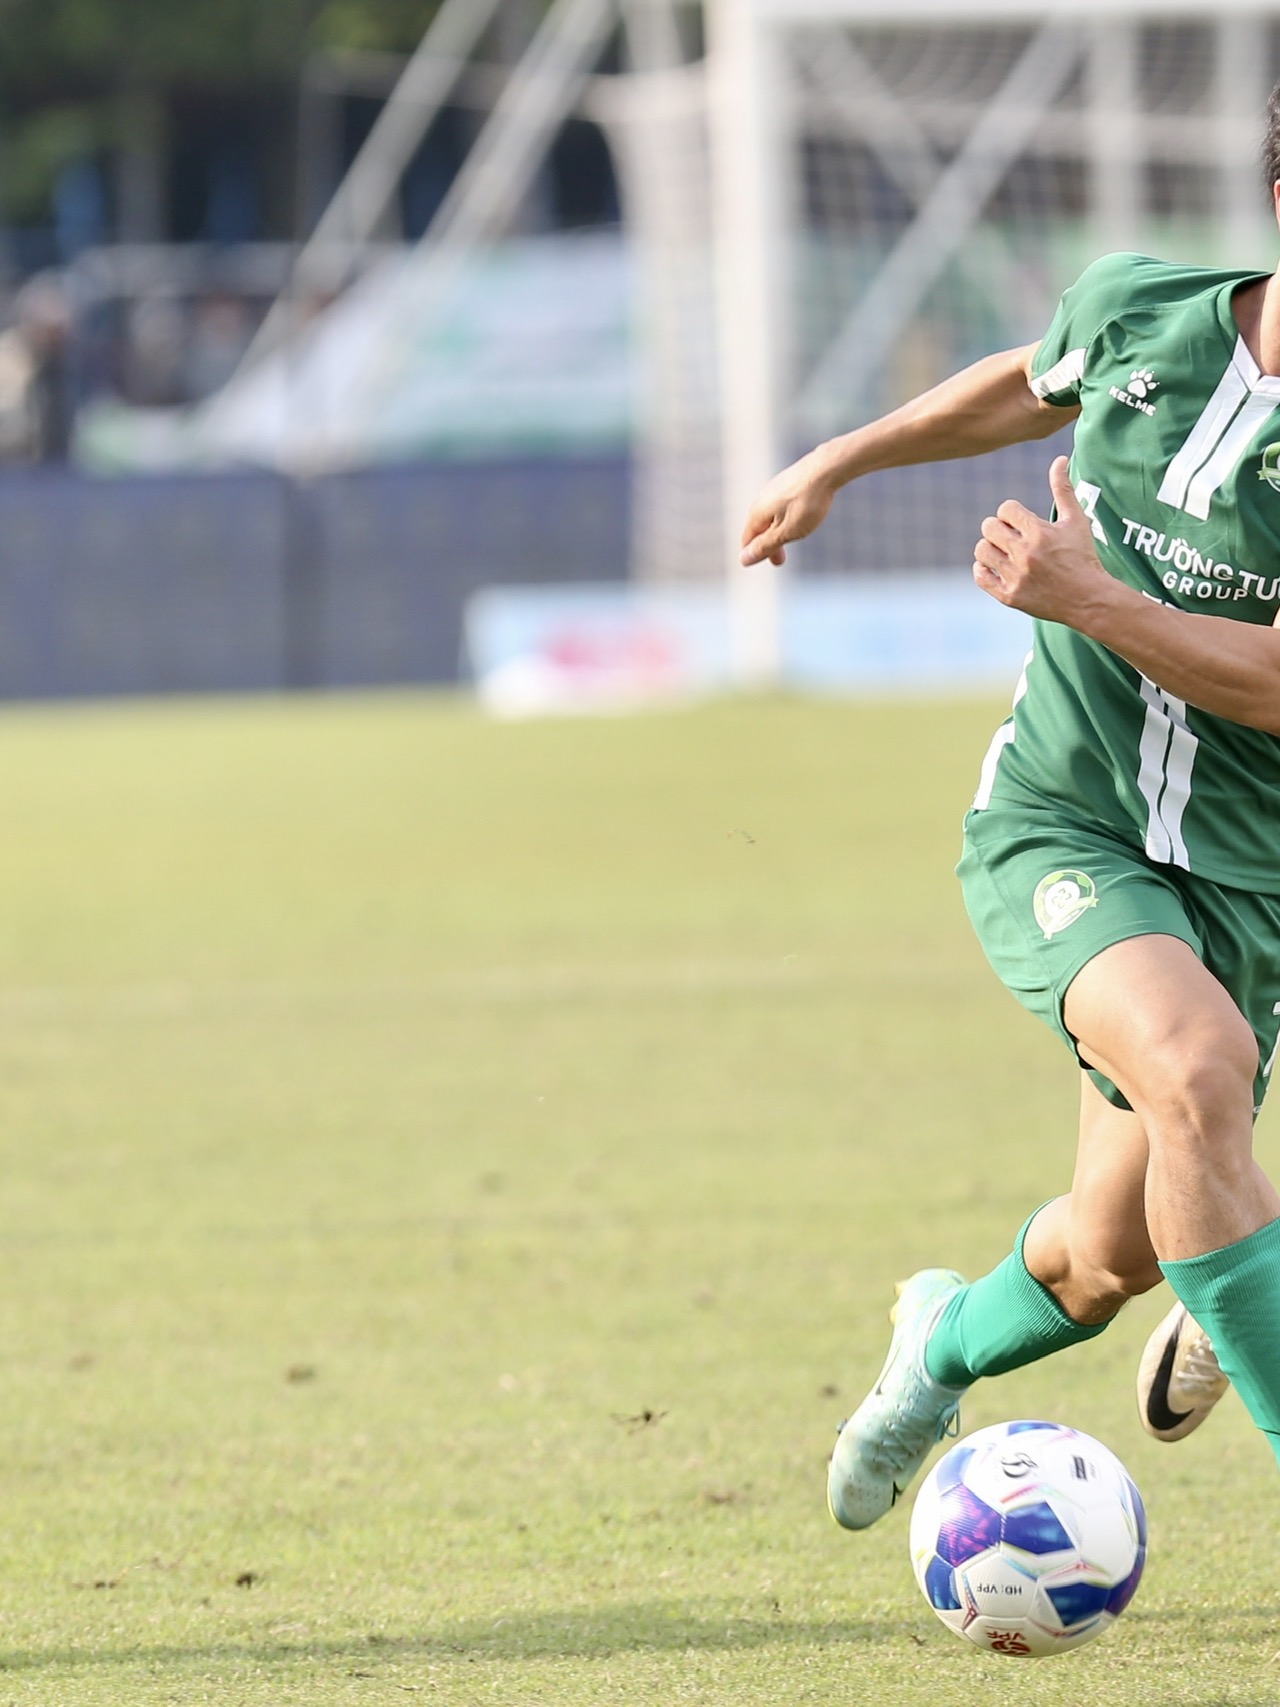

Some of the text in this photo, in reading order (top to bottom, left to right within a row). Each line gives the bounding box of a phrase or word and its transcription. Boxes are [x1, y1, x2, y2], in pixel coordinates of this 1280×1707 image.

[1108, 385, 1157, 417] KELME
[1121, 517, 1234, 581] TRƯỜNG
[1161, 570, 1248, 601] GROUP
[976, 1582, 998, 1595] VPF
